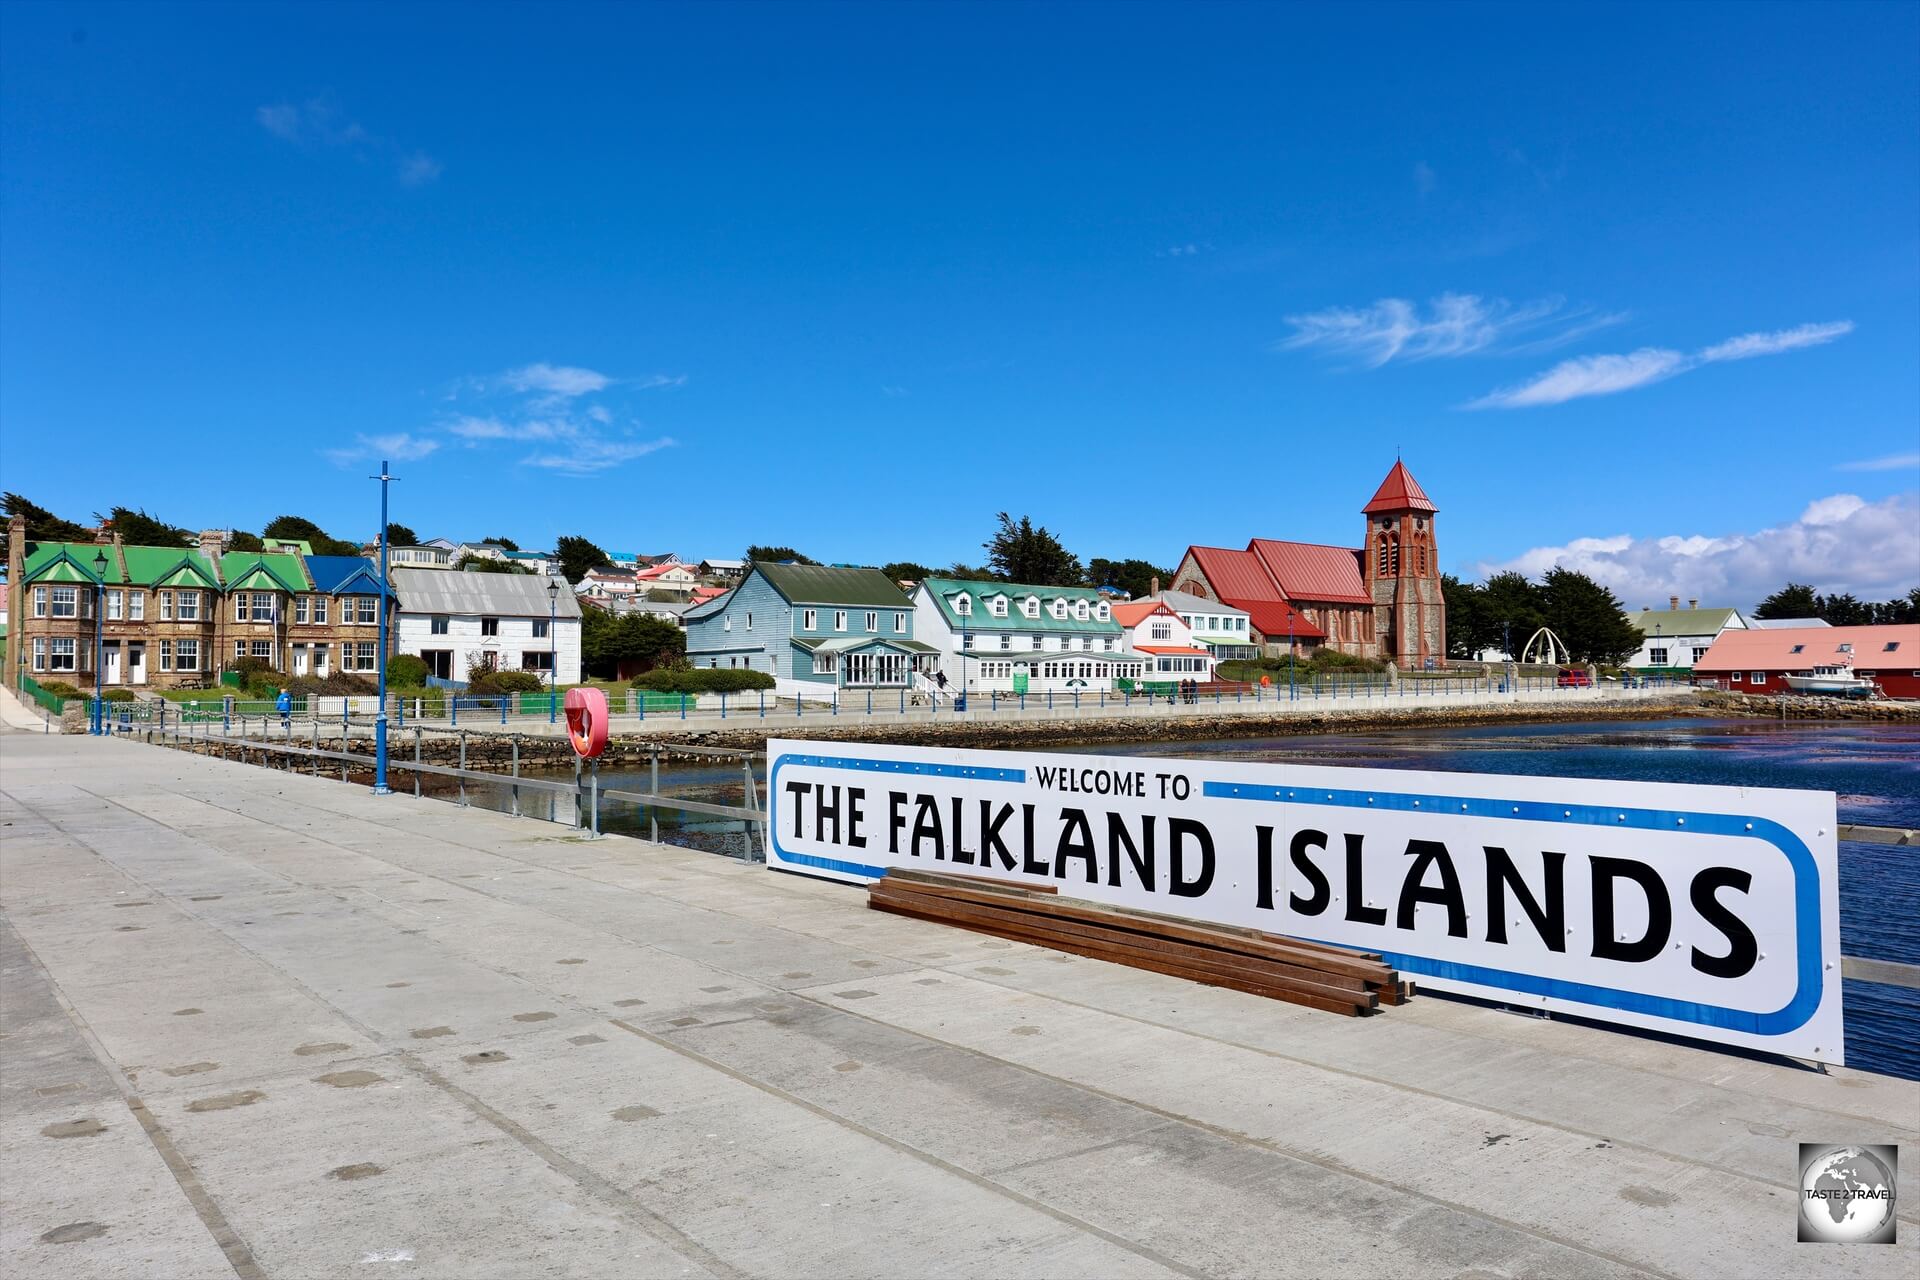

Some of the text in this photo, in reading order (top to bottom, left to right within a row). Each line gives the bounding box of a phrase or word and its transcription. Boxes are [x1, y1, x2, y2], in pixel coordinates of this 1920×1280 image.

[1035, 766, 1190, 801] WELCOME TO
[785, 781, 1758, 979] THE FALKLAND ISLANDS
